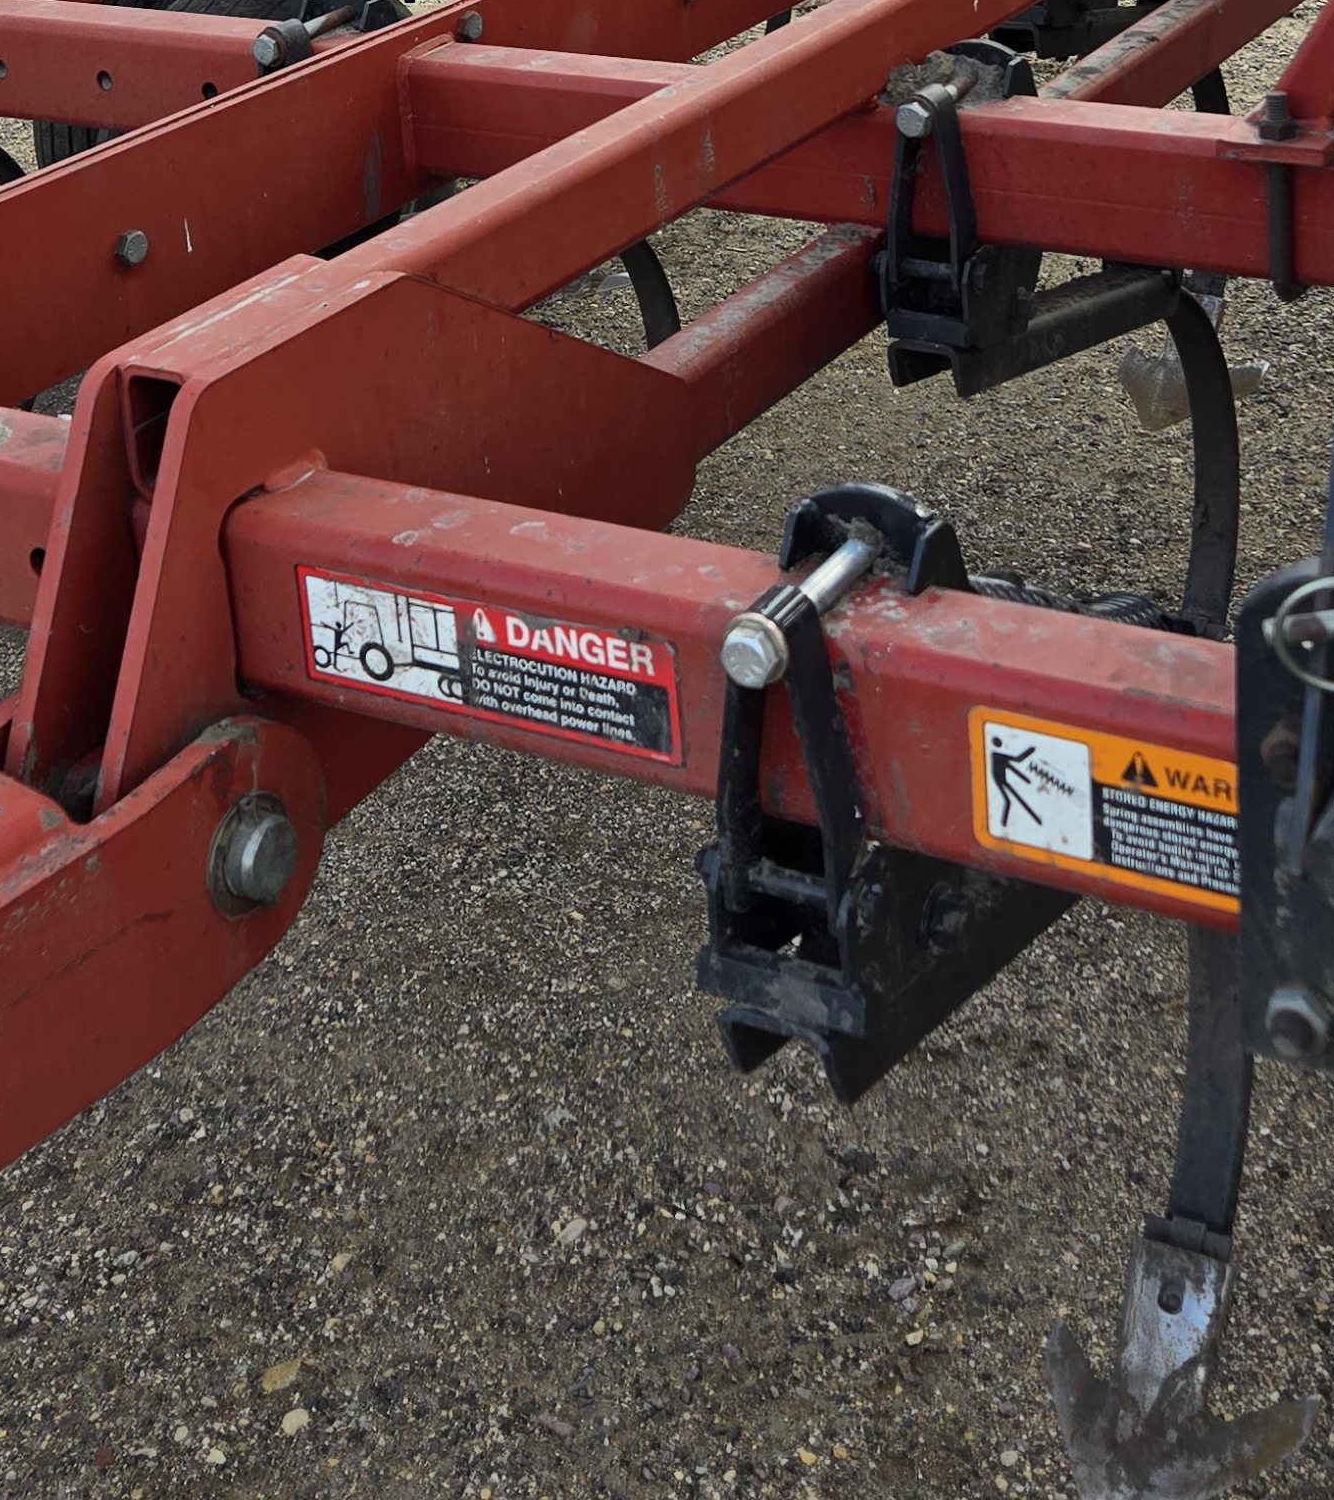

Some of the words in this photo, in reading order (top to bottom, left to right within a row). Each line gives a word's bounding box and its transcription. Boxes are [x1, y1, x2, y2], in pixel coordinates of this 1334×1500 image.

[505, 615, 655, 677] DANGER
[471, 662, 485, 677] To
[488, 667, 521, 685] avoid
[562, 685, 576, 698] or
[580, 672, 637, 696] HAZARD
[471, 677, 491, 693] DO
[493, 681, 520, 700] NOT
[523, 691, 558, 708] come
[587, 706, 635, 727] contact
[501, 701, 559, 722] overhead
[560, 714, 599, 733] power
[1101, 786, 1147, 809] STORED
[1149, 798, 1195, 820] ENERGY
[1197, 809, 1238, 831] HAZAR
[1102, 802, 1140, 824] Spring
[1140, 813, 1204, 838] assemblies
[1205, 826, 1235, 845] have
[1102, 816, 1161, 840] dangerous
[1162, 830, 1198, 848] stored
[1111, 828, 1124, 843] To
[1126, 834, 1157, 851] avoid
[1158, 840, 1193, 860] bodily
[1111, 851, 1176, 879] Instructions
[1177, 870, 1200, 885] and
[1170, 853, 1211, 875] Manual
